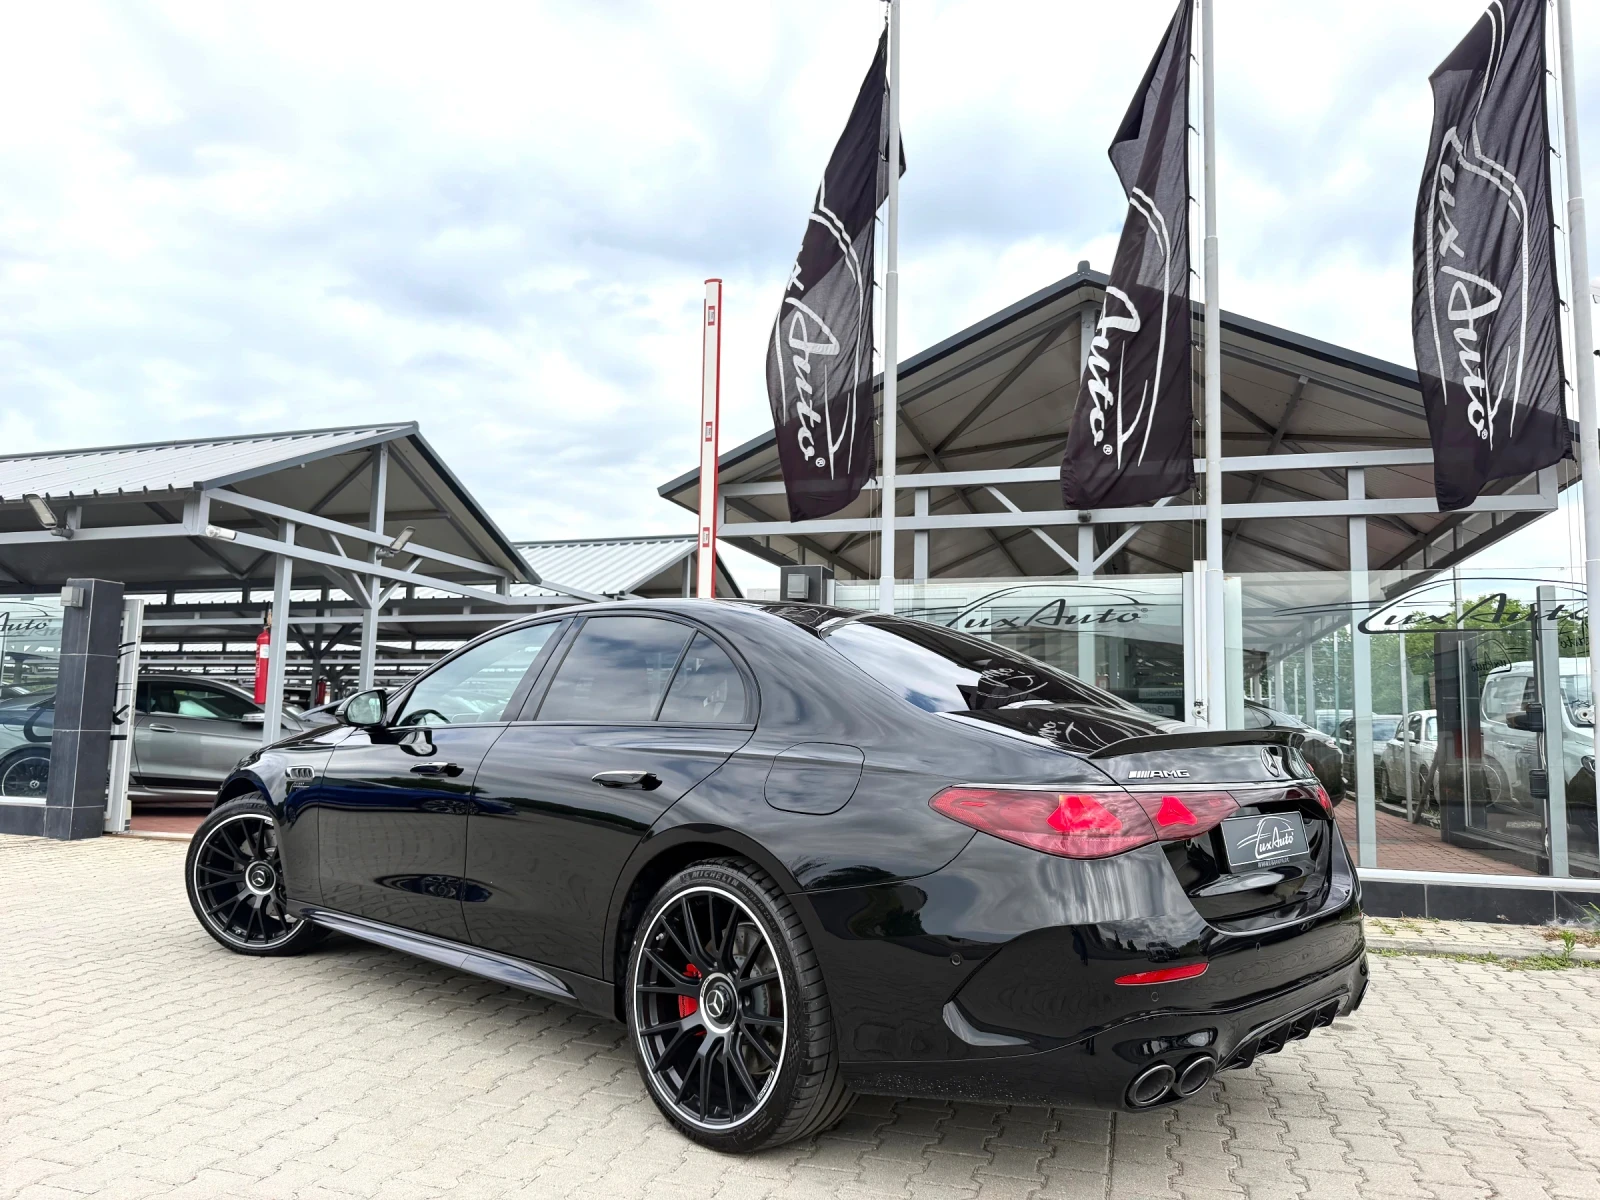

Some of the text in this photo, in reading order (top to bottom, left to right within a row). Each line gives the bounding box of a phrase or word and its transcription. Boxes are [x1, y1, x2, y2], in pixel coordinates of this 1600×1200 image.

[0, 611, 49, 632] Auto
[1149, 769, 1190, 778] AMG
[691, 870, 740, 887] MICHELIN
